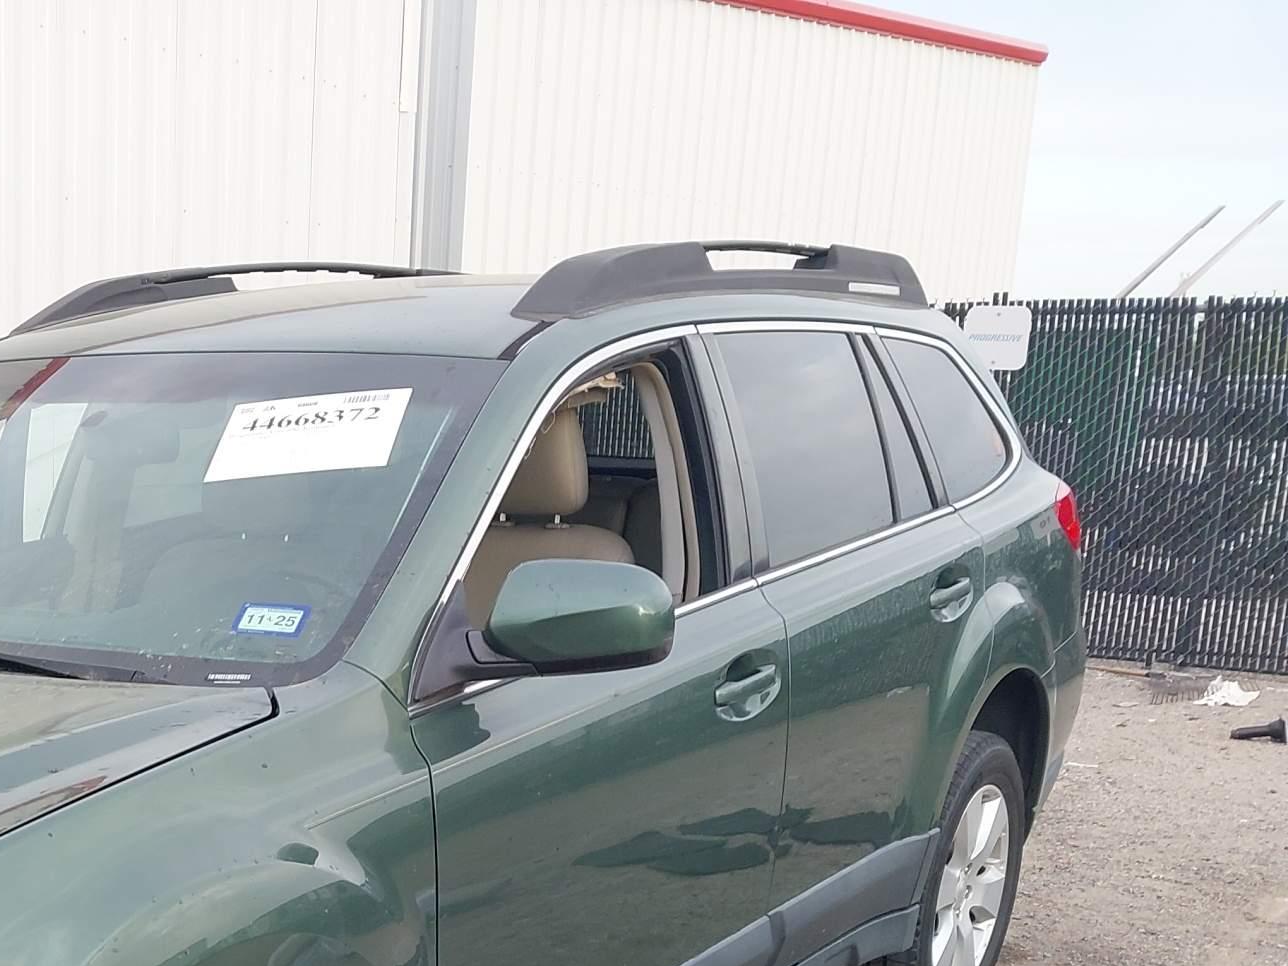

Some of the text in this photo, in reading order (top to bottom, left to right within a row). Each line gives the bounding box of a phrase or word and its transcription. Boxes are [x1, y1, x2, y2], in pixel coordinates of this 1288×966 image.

[242, 406, 382, 432] 44668372
[247, 613, 299, 628] 11 25
